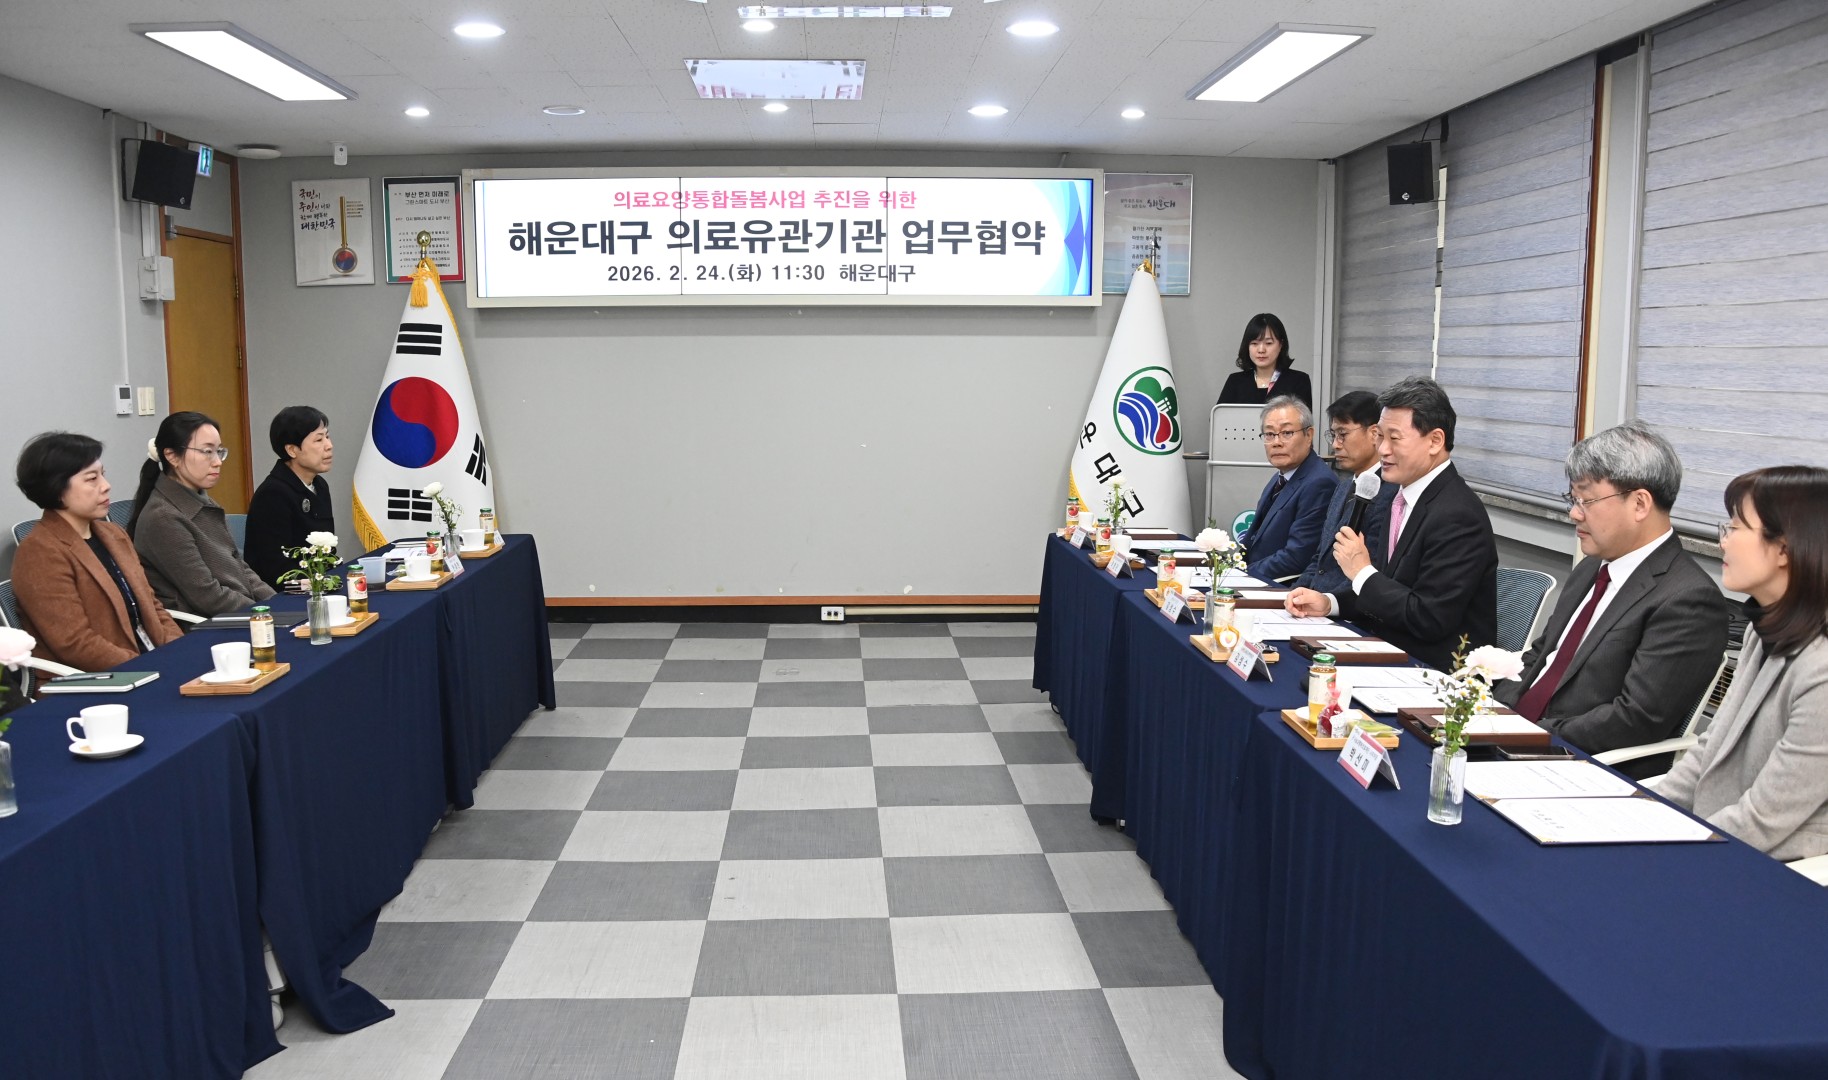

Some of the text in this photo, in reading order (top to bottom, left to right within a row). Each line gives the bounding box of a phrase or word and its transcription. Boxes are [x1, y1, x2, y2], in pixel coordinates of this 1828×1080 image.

[613, 190, 917, 210] 의료요양통합돌봄사업 추진을 위한
[508, 219, 1046, 257] 해운대구 의료유관기관 업무협약
[608, 264, 917, 283] 2026. 2. 24.(화) 11:30 해운대구
